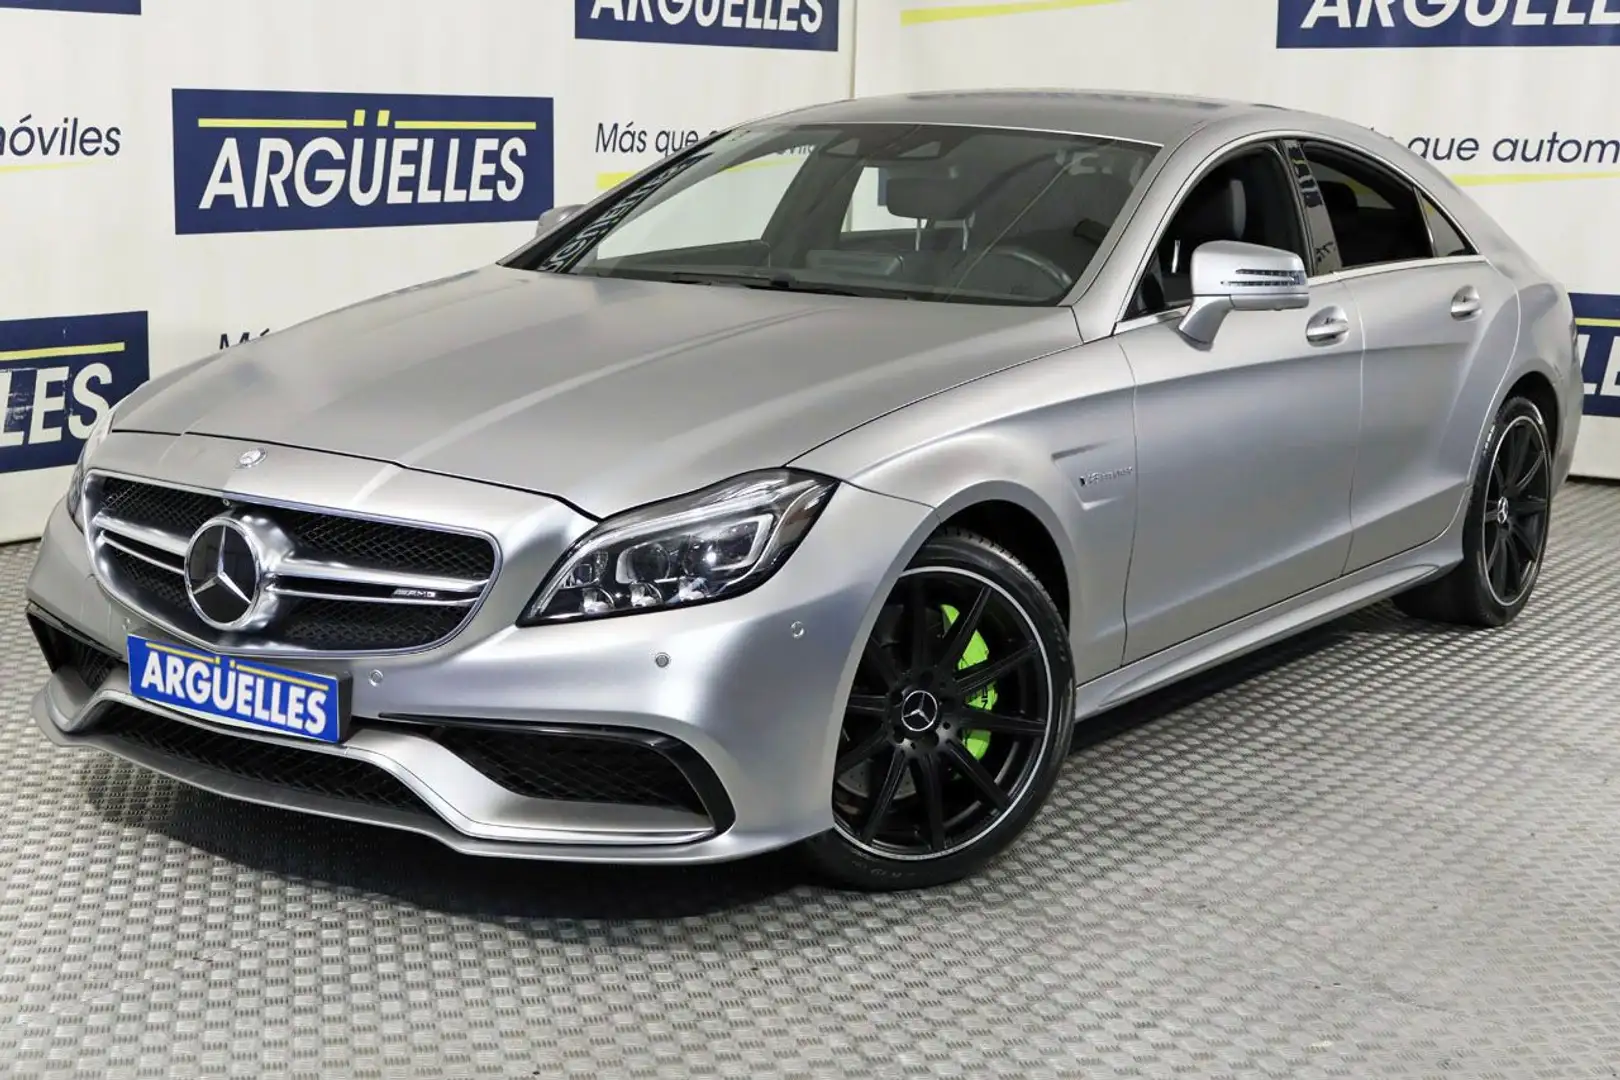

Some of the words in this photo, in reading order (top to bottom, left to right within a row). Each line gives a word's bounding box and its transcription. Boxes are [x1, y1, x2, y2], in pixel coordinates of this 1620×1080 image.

[198, 109, 527, 209] ARGÜELLES
[595, 121, 647, 153] Más
[141, 651, 328, 735] ARGÜELLES
